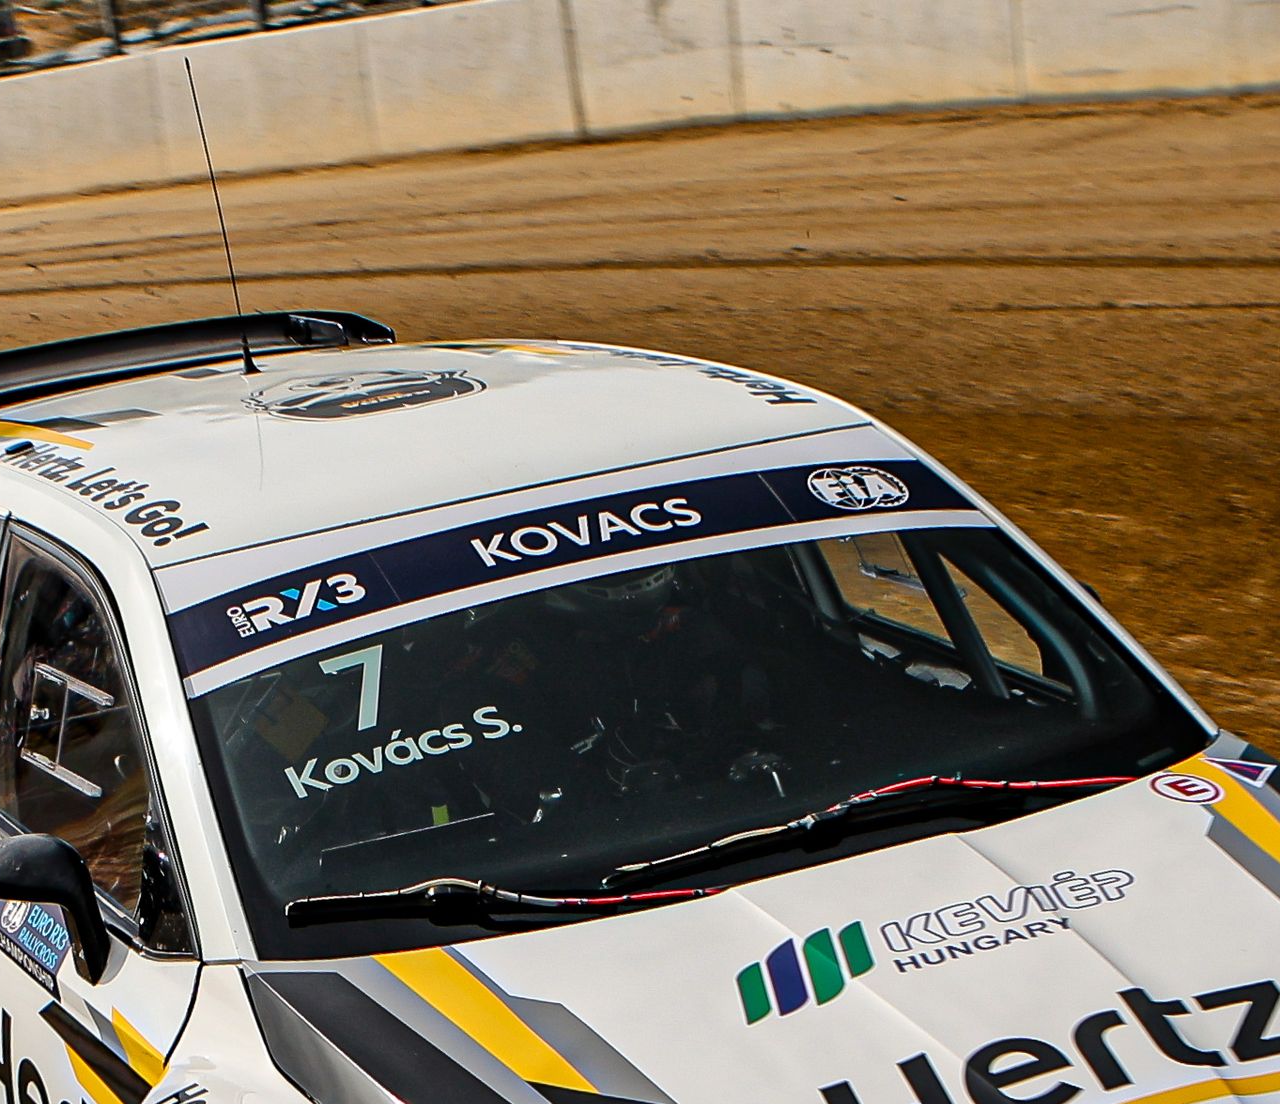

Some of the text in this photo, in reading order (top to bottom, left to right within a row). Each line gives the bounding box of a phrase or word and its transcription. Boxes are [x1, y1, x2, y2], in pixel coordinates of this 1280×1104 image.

[65, 467, 150, 510] Let's
[124, 500, 210, 547] Go!
[809, 472, 906, 505] FIA
[470, 497, 702, 567] KOVACS
[226, 573, 366, 638] EURO RX3
[318, 644, 383, 731] 7
[284, 705, 523, 798] Kovács S.
[27, 904, 70, 951] EURO RX3
[880, 870, 1135, 953] KEVIÉP
[893, 916, 1070, 973] HUNGARY
[18, 926, 59, 970] RALLYCROSS
